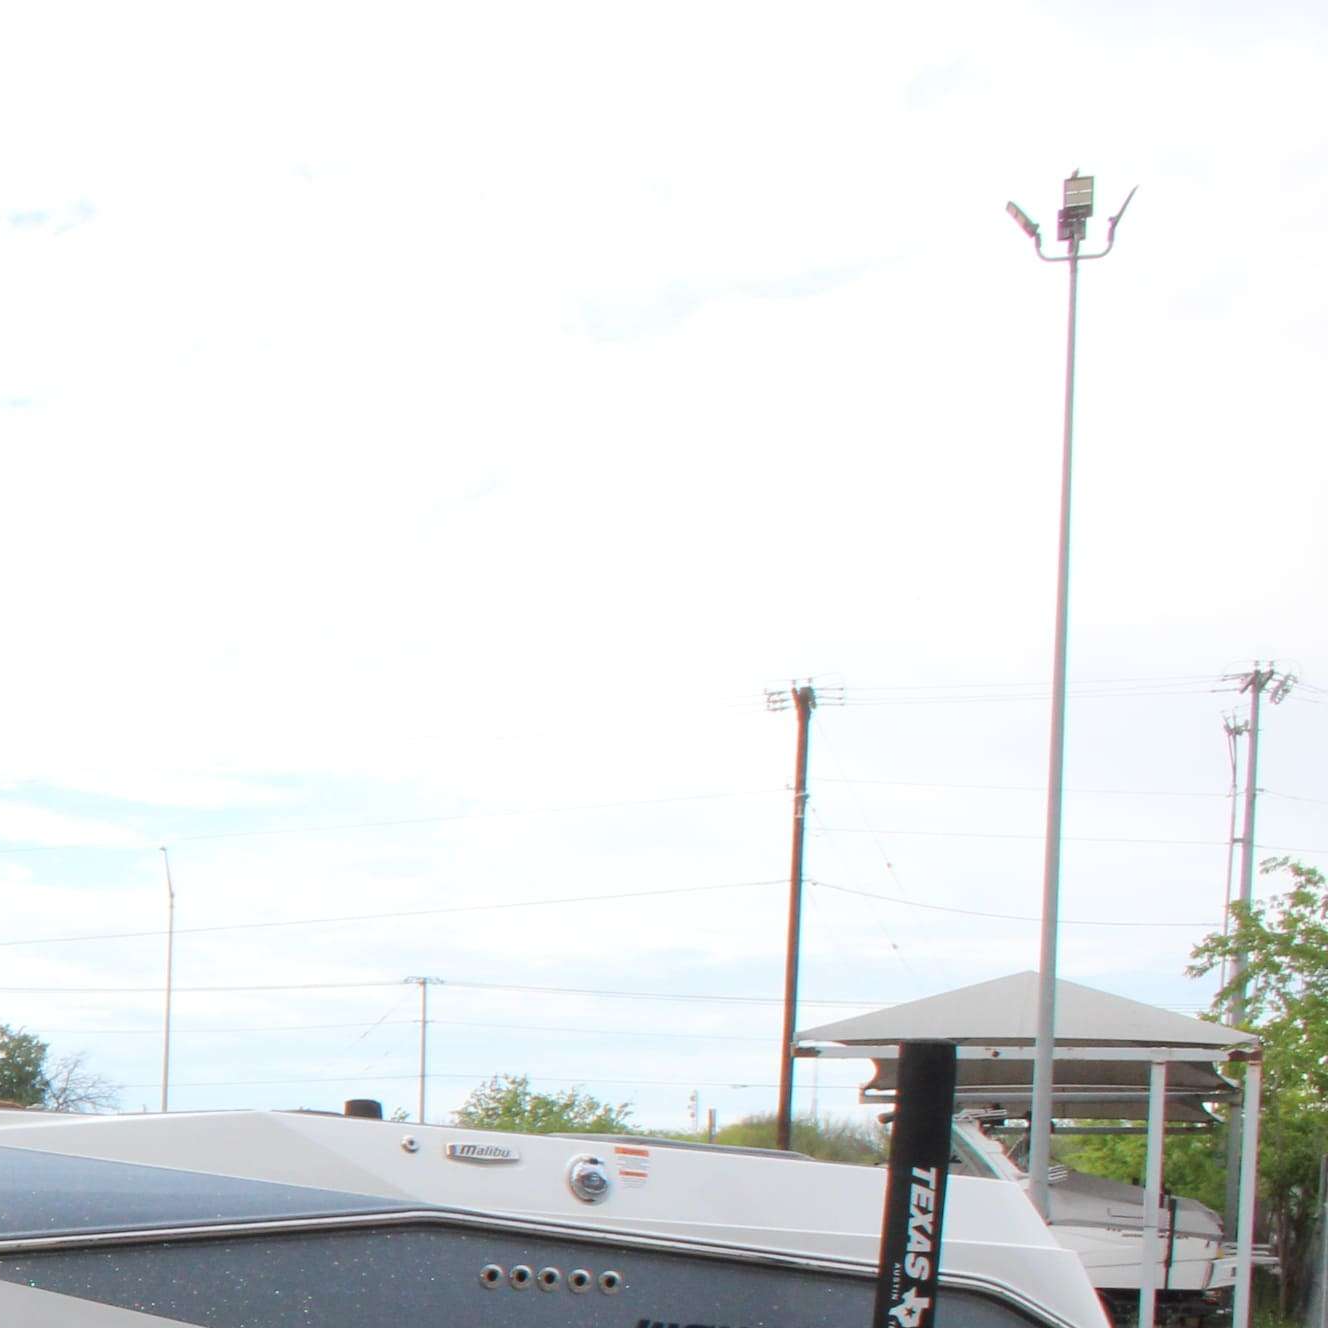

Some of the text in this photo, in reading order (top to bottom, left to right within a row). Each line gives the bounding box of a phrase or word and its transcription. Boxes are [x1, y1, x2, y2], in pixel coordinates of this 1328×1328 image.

[459, 1144, 511, 1158] Malibu
[904, 1166, 937, 1281] TEXAS
[891, 1262, 902, 1301] AUSTIN
